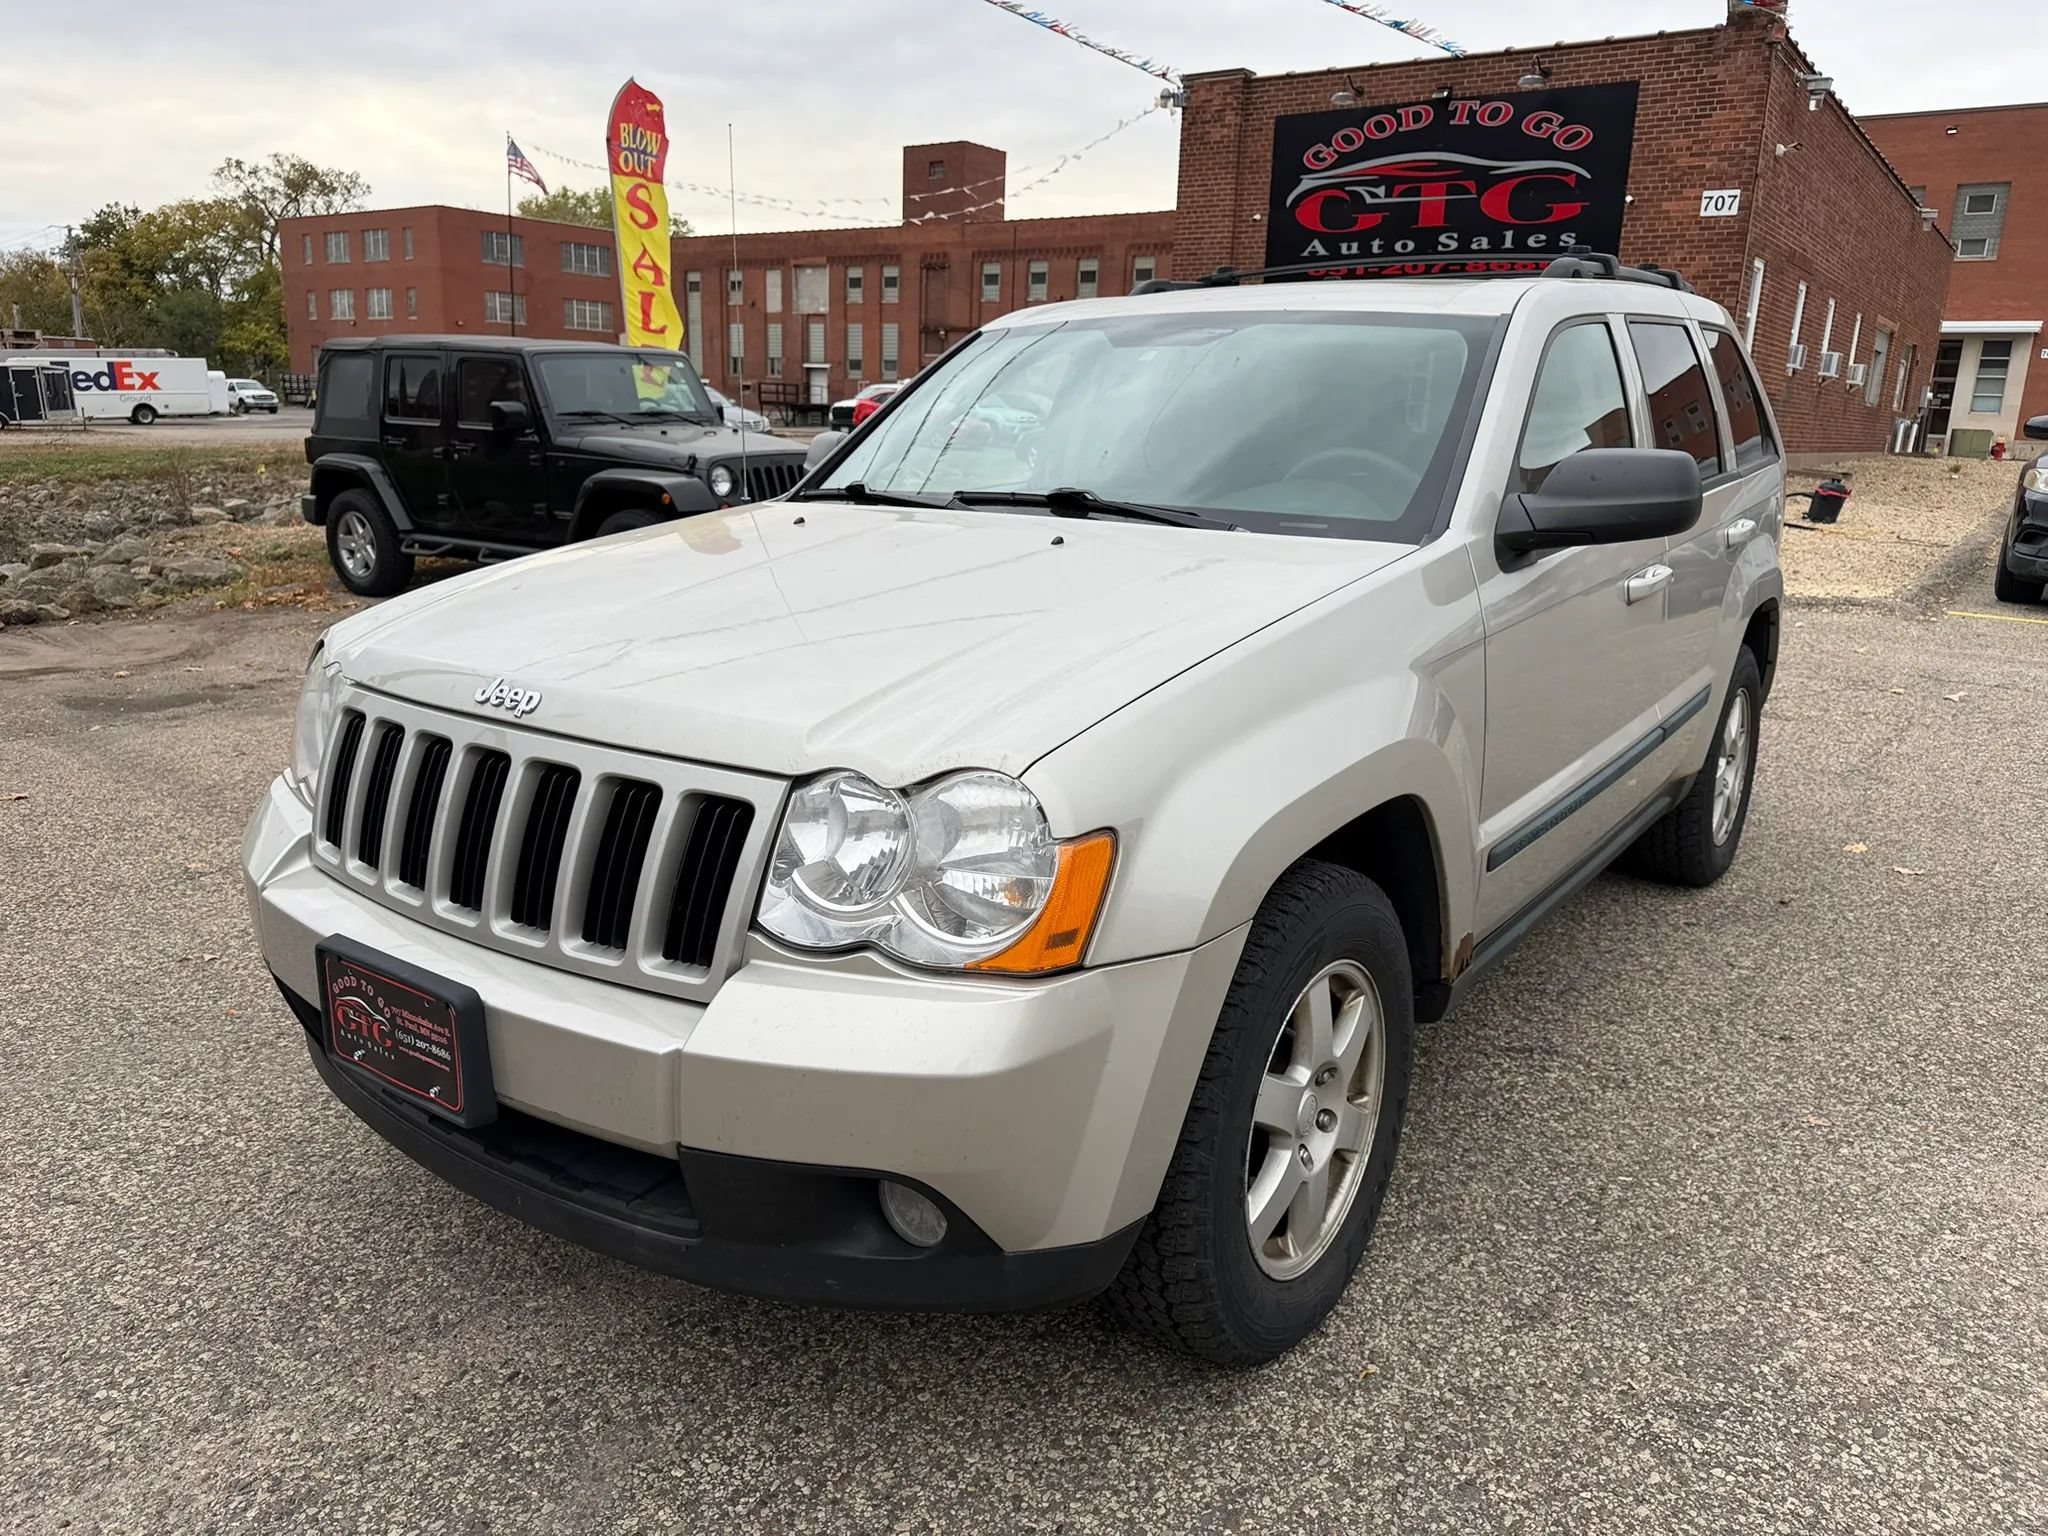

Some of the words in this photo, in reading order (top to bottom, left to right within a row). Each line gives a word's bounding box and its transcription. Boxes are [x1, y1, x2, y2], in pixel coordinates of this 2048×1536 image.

[619, 123, 661, 156] BLOW
[1303, 105, 1433, 170] GOOD
[1449, 100, 1513, 126] TO
[1521, 111, 1593, 151] GO
[619, 151, 656, 178] OUT
[1295, 173, 1590, 233] GTG
[1703, 195, 1738, 212] 707
[1300, 237, 1415, 257] Auto
[1437, 230, 1576, 252] Sales
[625, 183, 668, 348] SAL
[50, 361, 161, 391] edEx
[120, 393, 151, 402] Ground
[474, 677, 542, 718] Jeep
[332, 976, 357, 994] GOOD
[361, 979, 374, 996] TO
[377, 996, 390, 1018] GO
[336, 1006, 393, 1048] GTG
[395, 1029, 415, 1046] (651)
[415, 1039, 451, 1061] 207-8686
